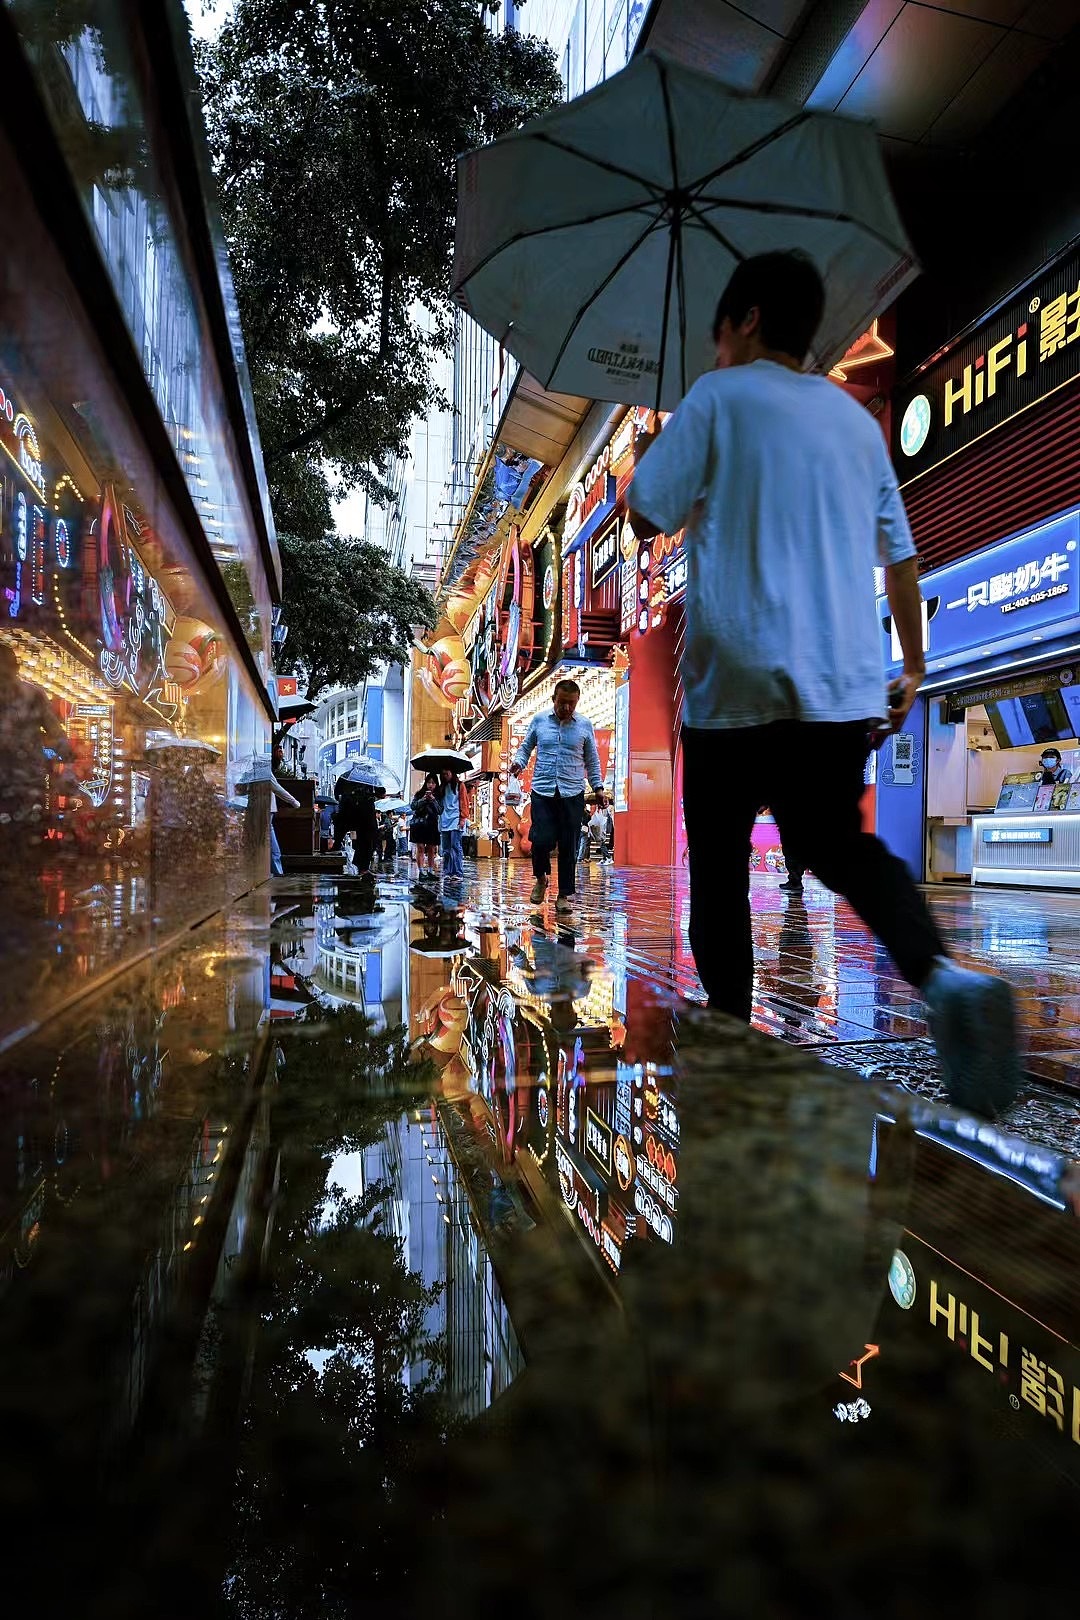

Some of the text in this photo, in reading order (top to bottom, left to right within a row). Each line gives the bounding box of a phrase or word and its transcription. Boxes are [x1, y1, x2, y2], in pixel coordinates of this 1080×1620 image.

[945, 323, 1028, 427] HiFi
[946, 552, 1070, 612] 一只酸奶牛
